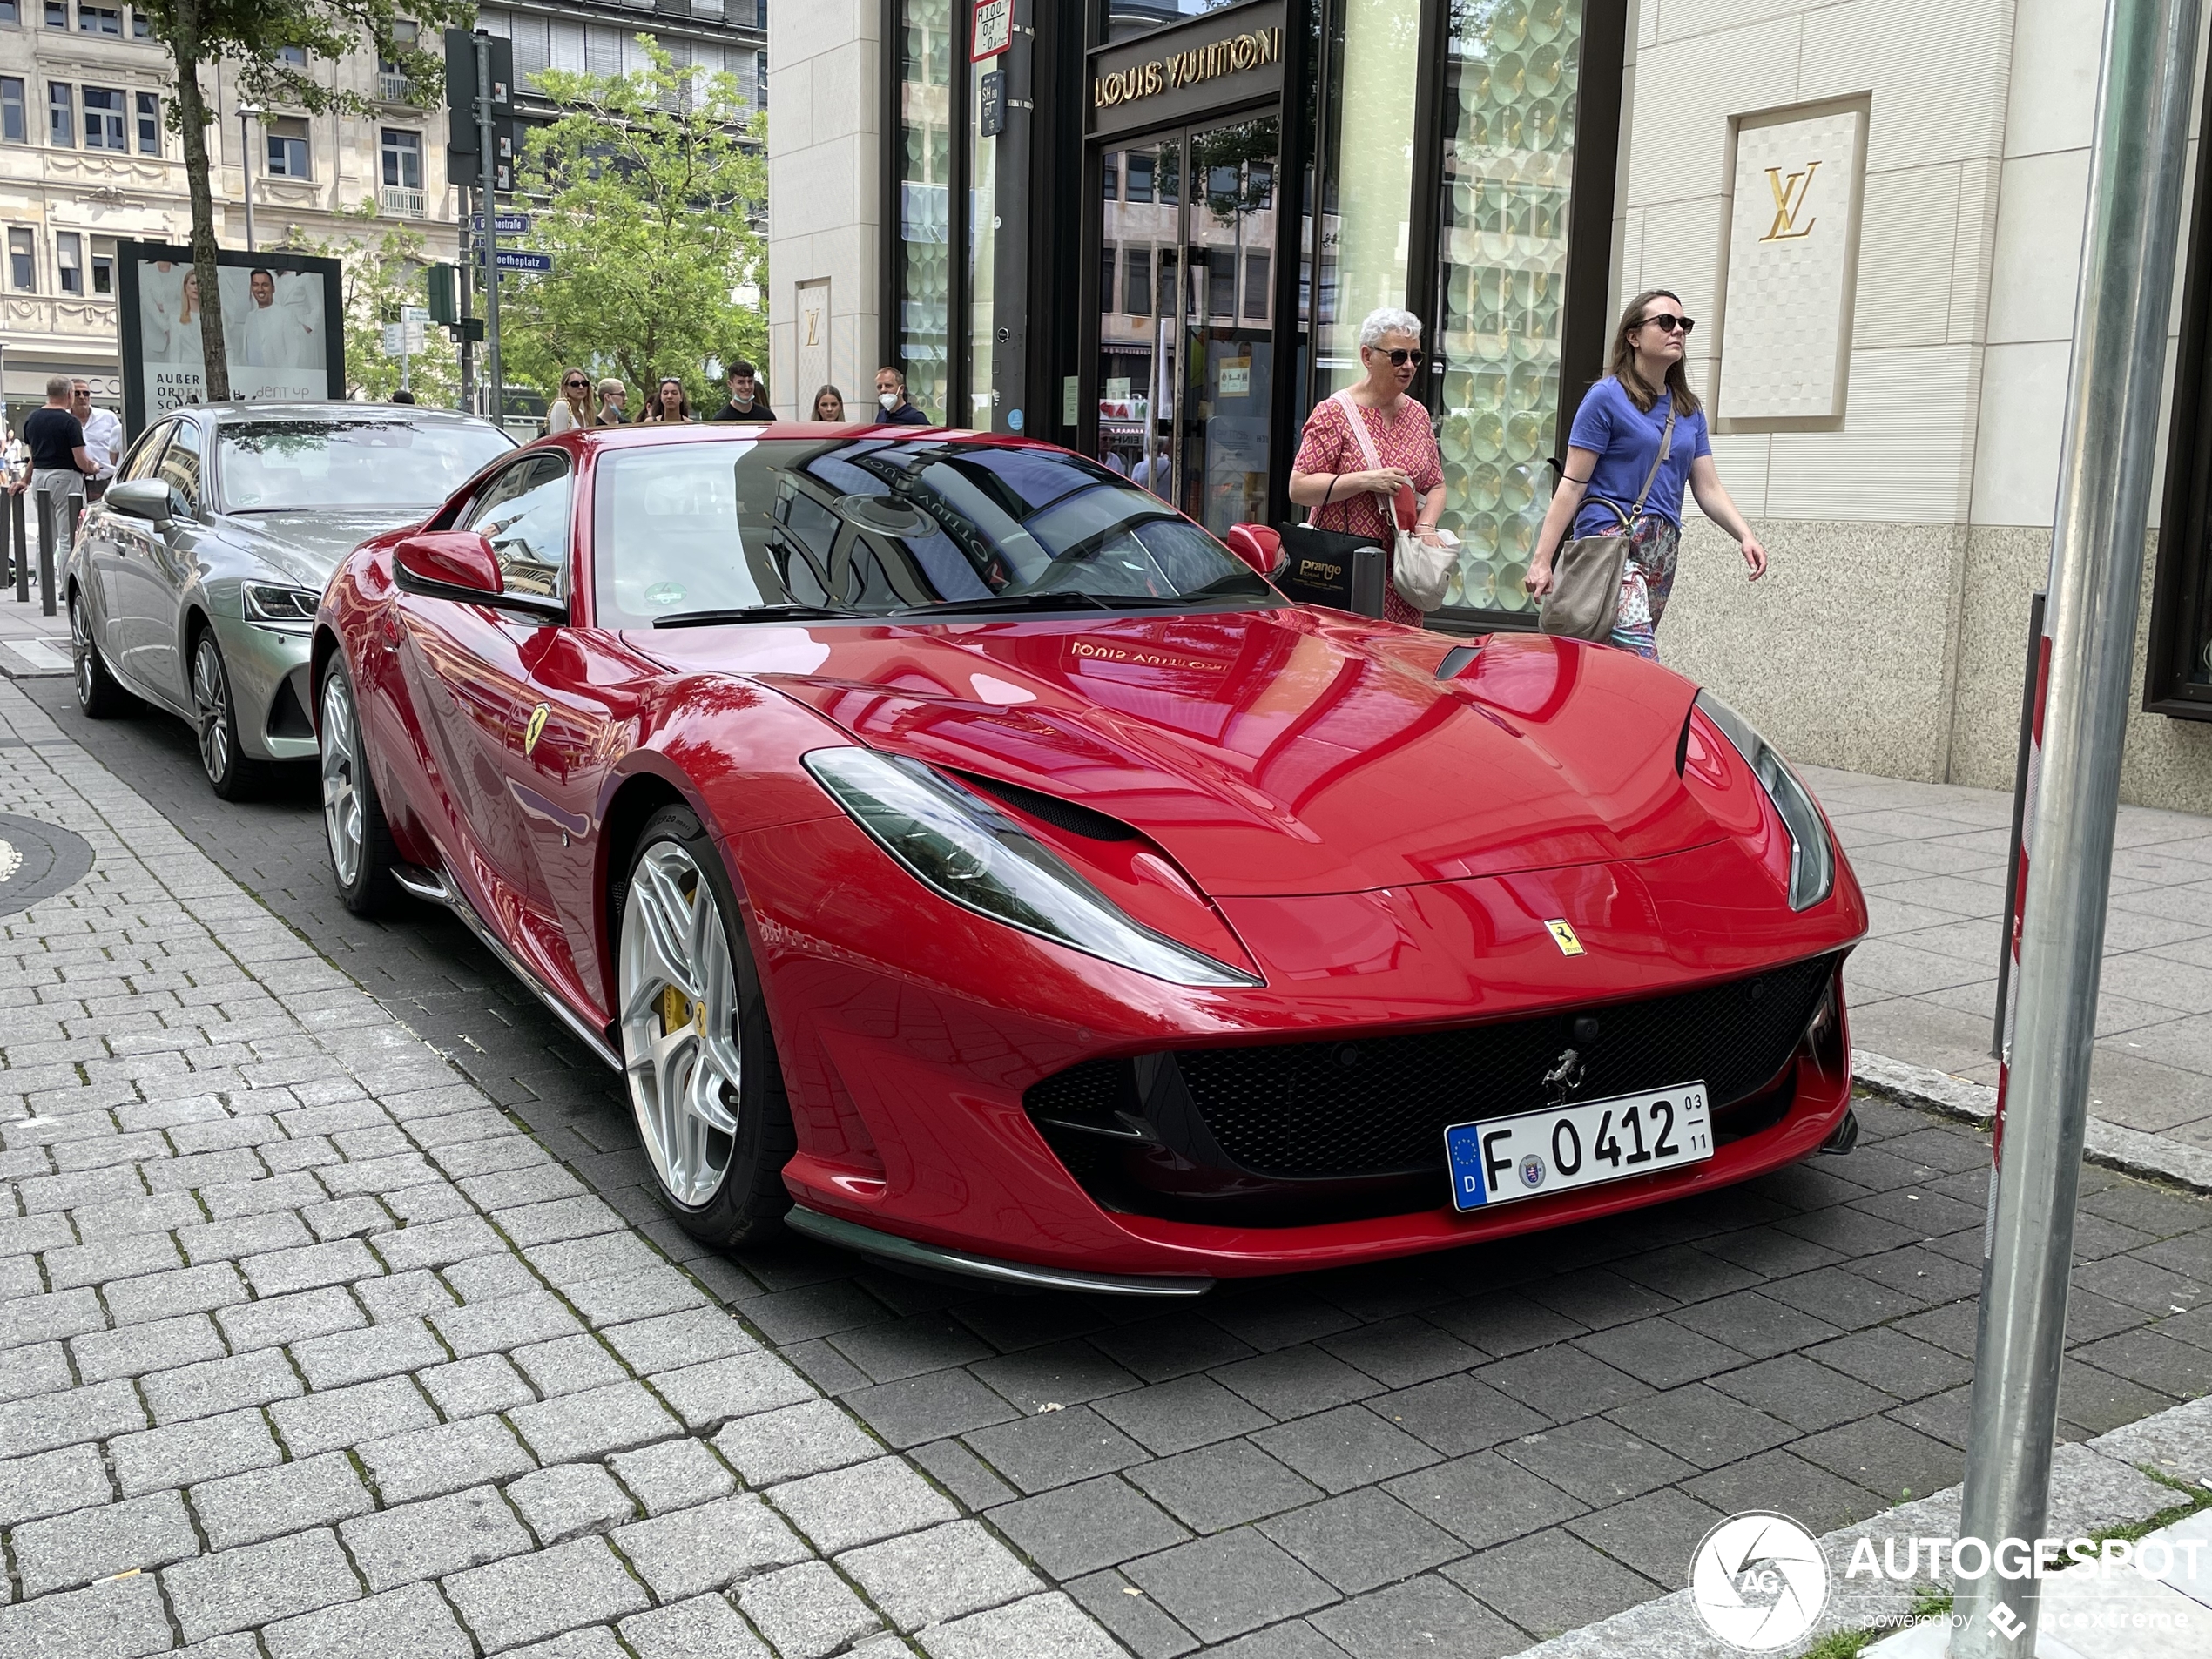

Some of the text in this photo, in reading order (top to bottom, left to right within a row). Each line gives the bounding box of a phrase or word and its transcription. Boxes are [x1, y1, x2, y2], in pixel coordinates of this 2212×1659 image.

[1095, 26, 1279, 108] LOUIS VUITTON
[496, 255, 541, 269] oetheplatz
[1299, 559, 1342, 581] prange
[1684, 1094, 1703, 1110] 03
[1482, 1129, 1513, 1191] F
[1595, 1100, 1680, 1167] 412
[1689, 1133, 1707, 1150] 11
[1465, 1175, 1476, 1193] D
